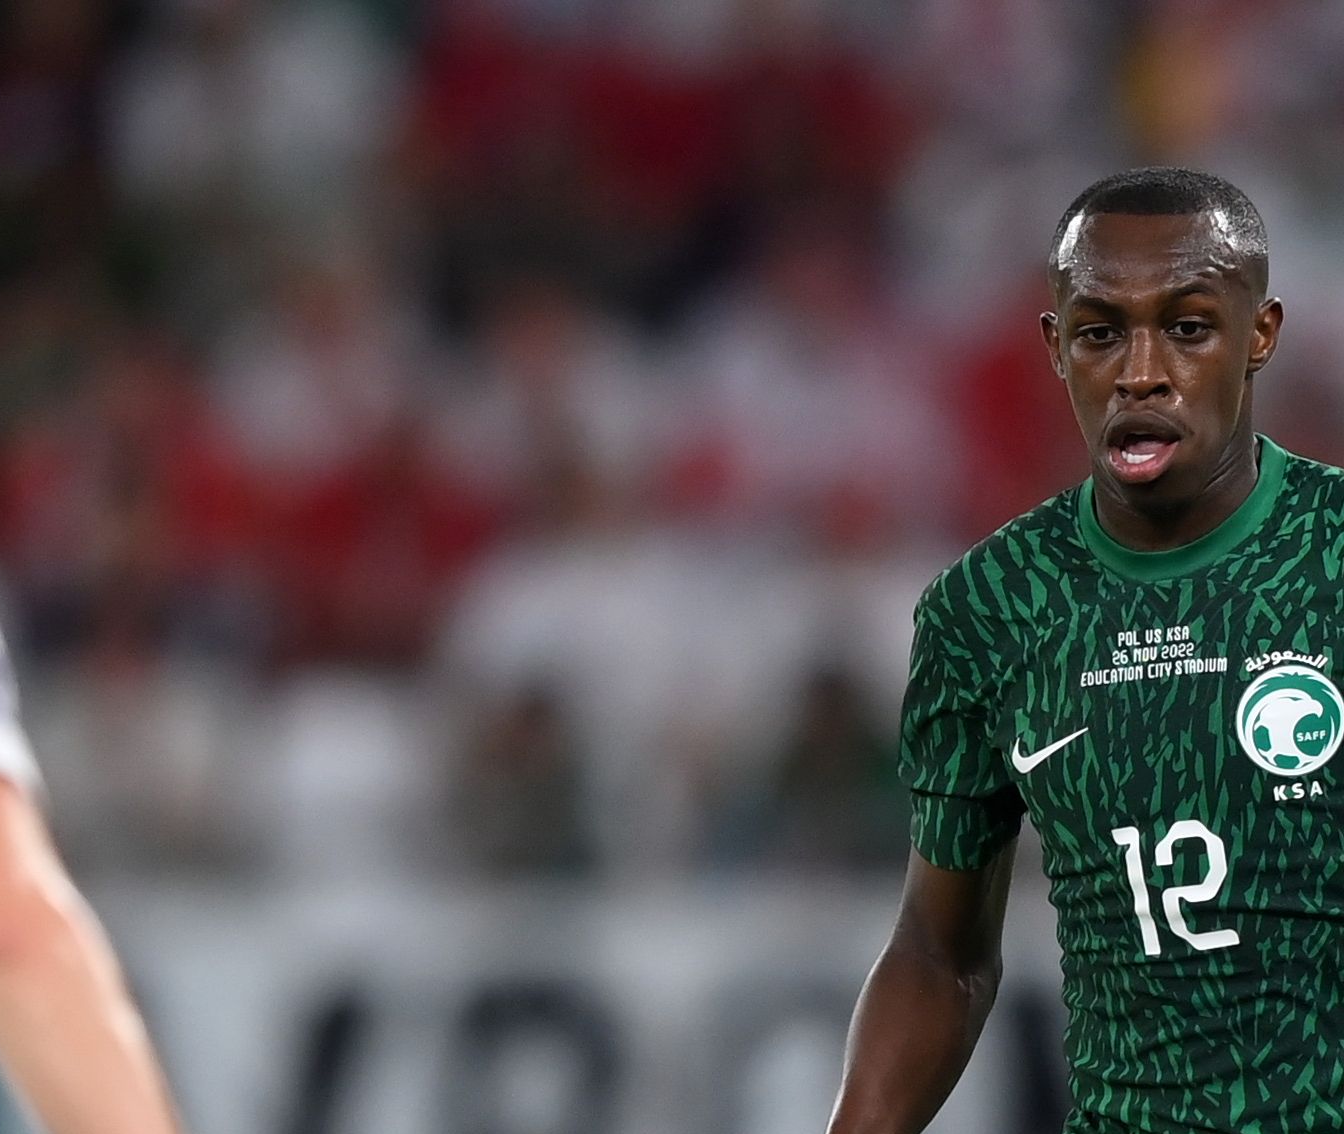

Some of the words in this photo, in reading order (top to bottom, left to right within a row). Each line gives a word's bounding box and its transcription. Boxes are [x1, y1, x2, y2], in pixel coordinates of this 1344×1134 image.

[1117, 631, 1141, 647] POL
[1166, 625, 1190, 642] KSA
[1112, 649, 1129, 666] 26
[1161, 642, 1195, 660] 2022
[1244, 650, 1329, 673] السعودية
[1080, 664, 1144, 688] EDUCATION
[1147, 661, 1172, 680] CITY
[1174, 657, 1228, 676] STADIUM
[1296, 729, 1327, 742] SAFF
[1273, 780, 1323, 802] KSA
[1111, 819, 1241, 956] 12
